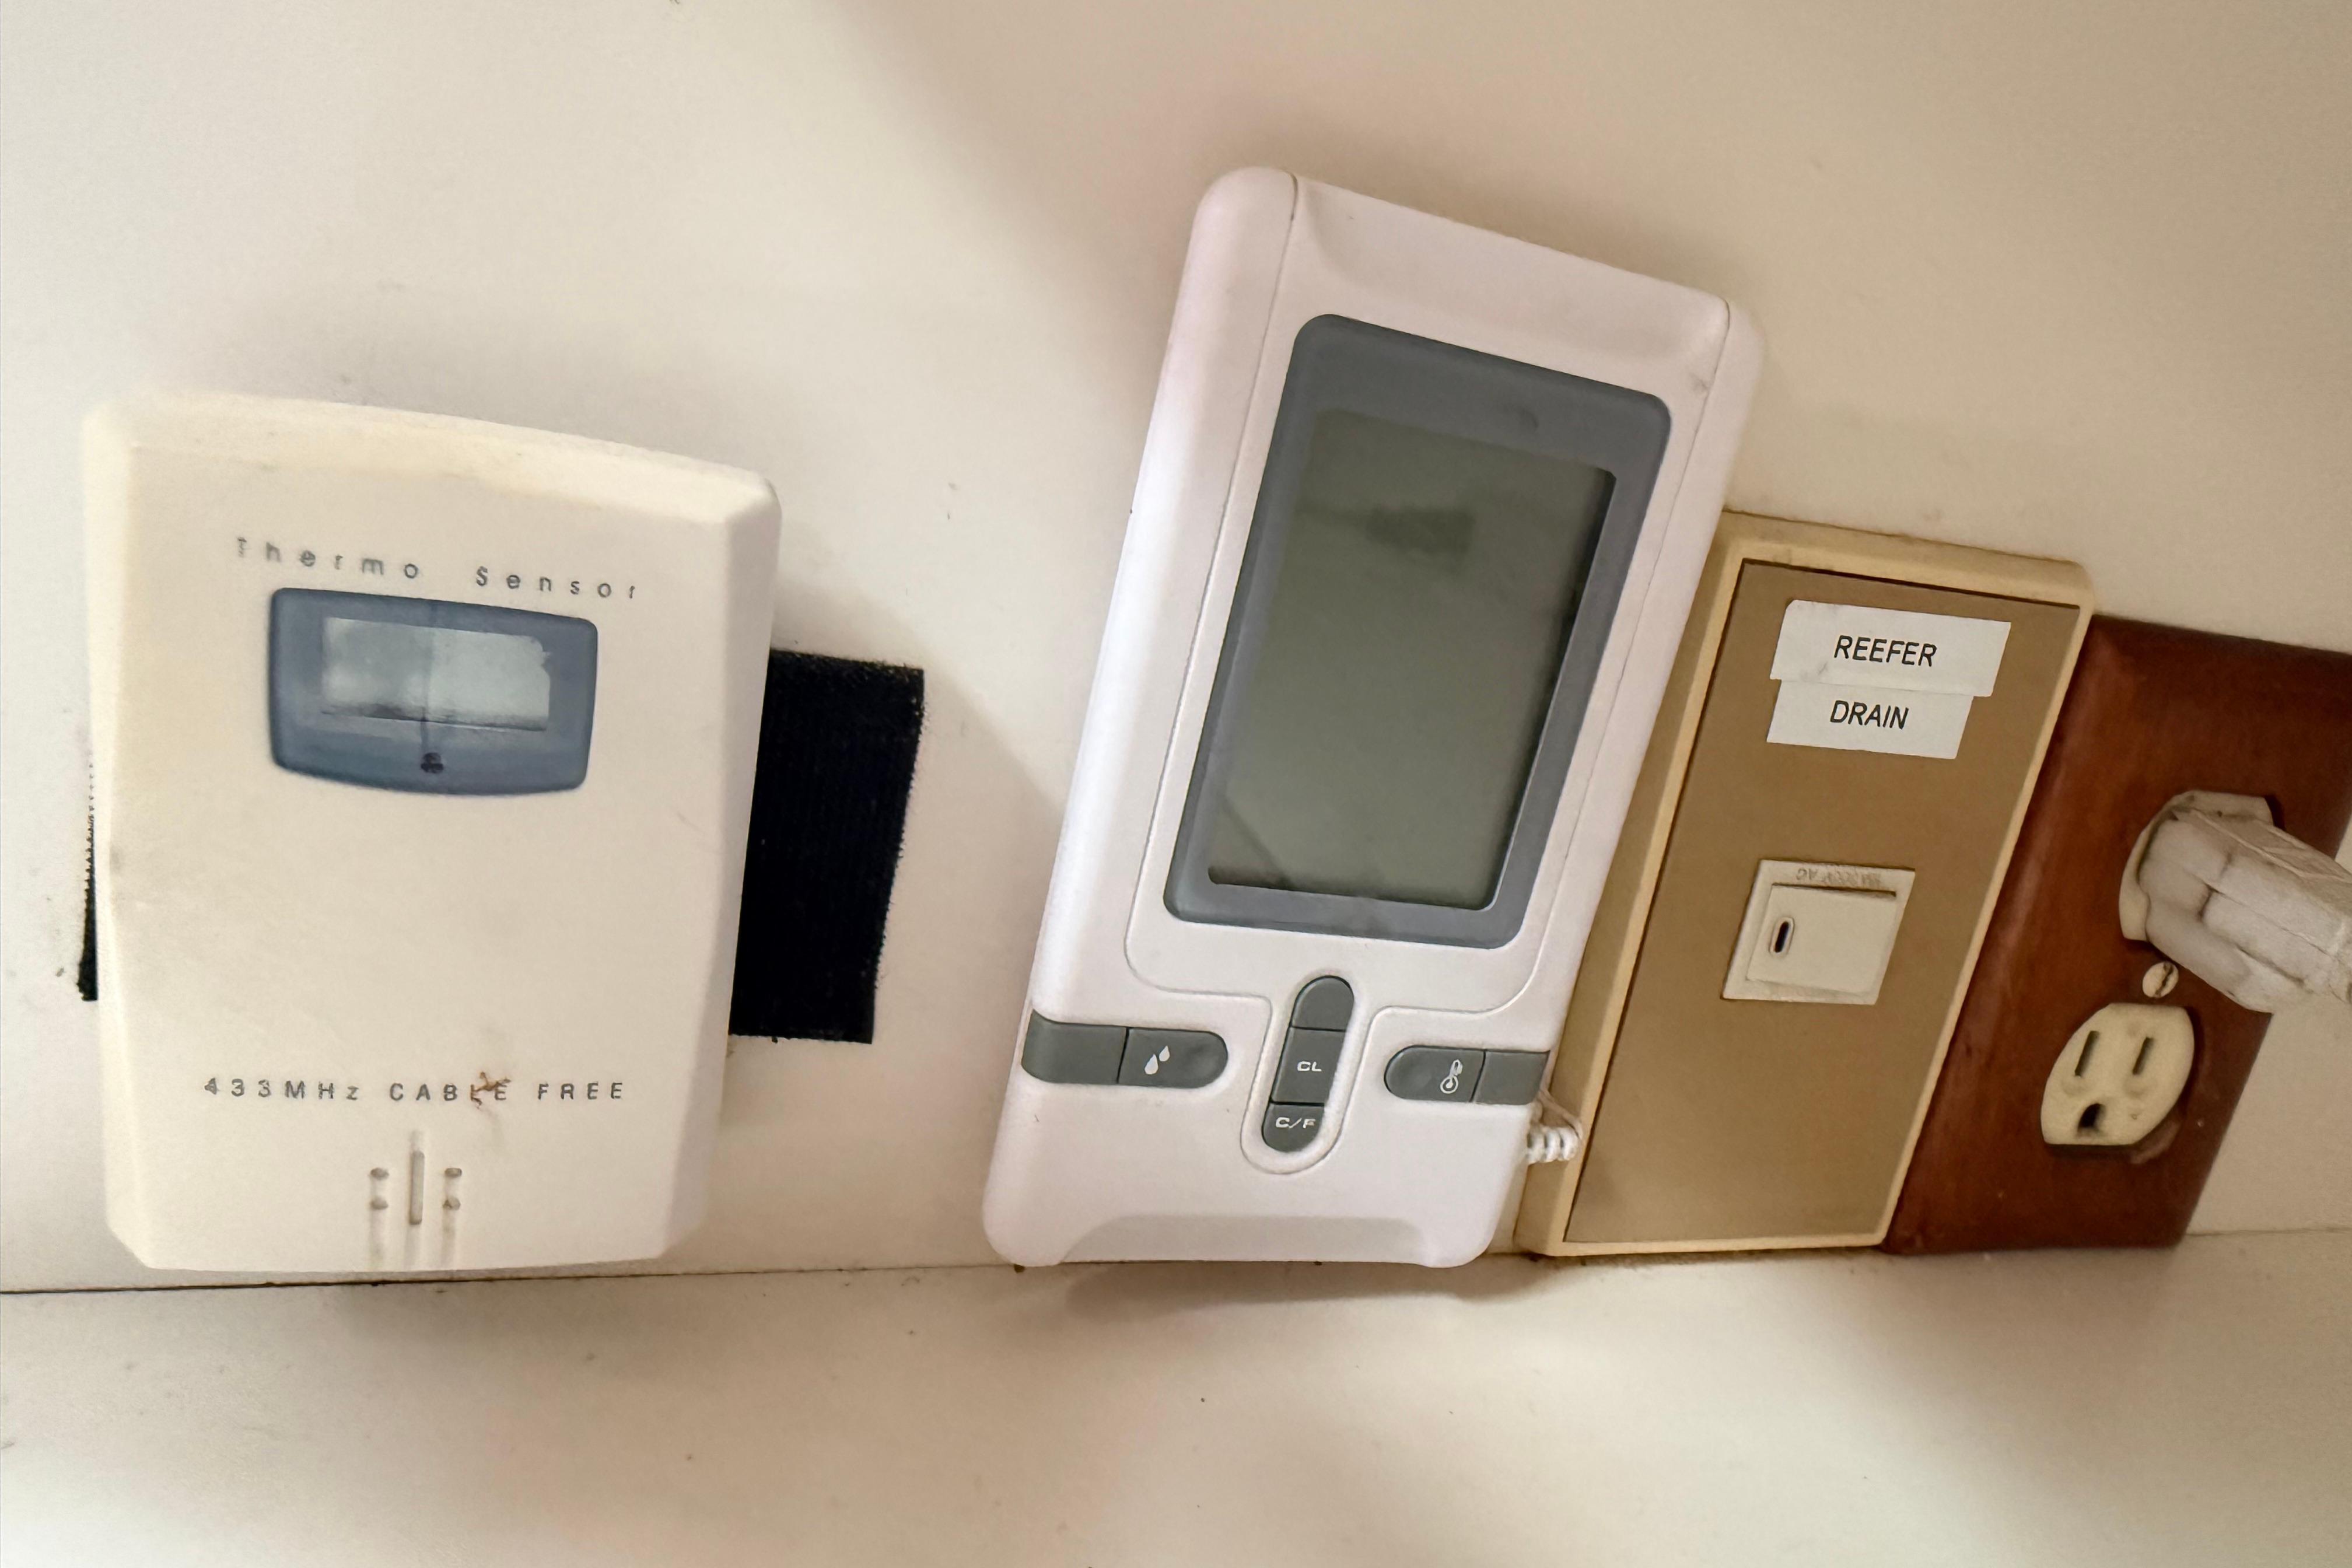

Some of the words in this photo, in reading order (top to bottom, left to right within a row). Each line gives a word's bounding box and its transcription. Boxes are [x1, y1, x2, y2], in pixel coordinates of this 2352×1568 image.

[237, 537, 419, 579] Thermo
[475, 565, 635, 599] Sensor
[1833, 635, 1937, 667] REEFER
[1829, 699, 1909, 730] DRAIN
[1297, 1060, 1322, 1072] CL
[204, 1077, 359, 1101] 433MHz
[538, 1082, 623, 1101] FREE
[1275, 1116, 1316, 1129] C/F
